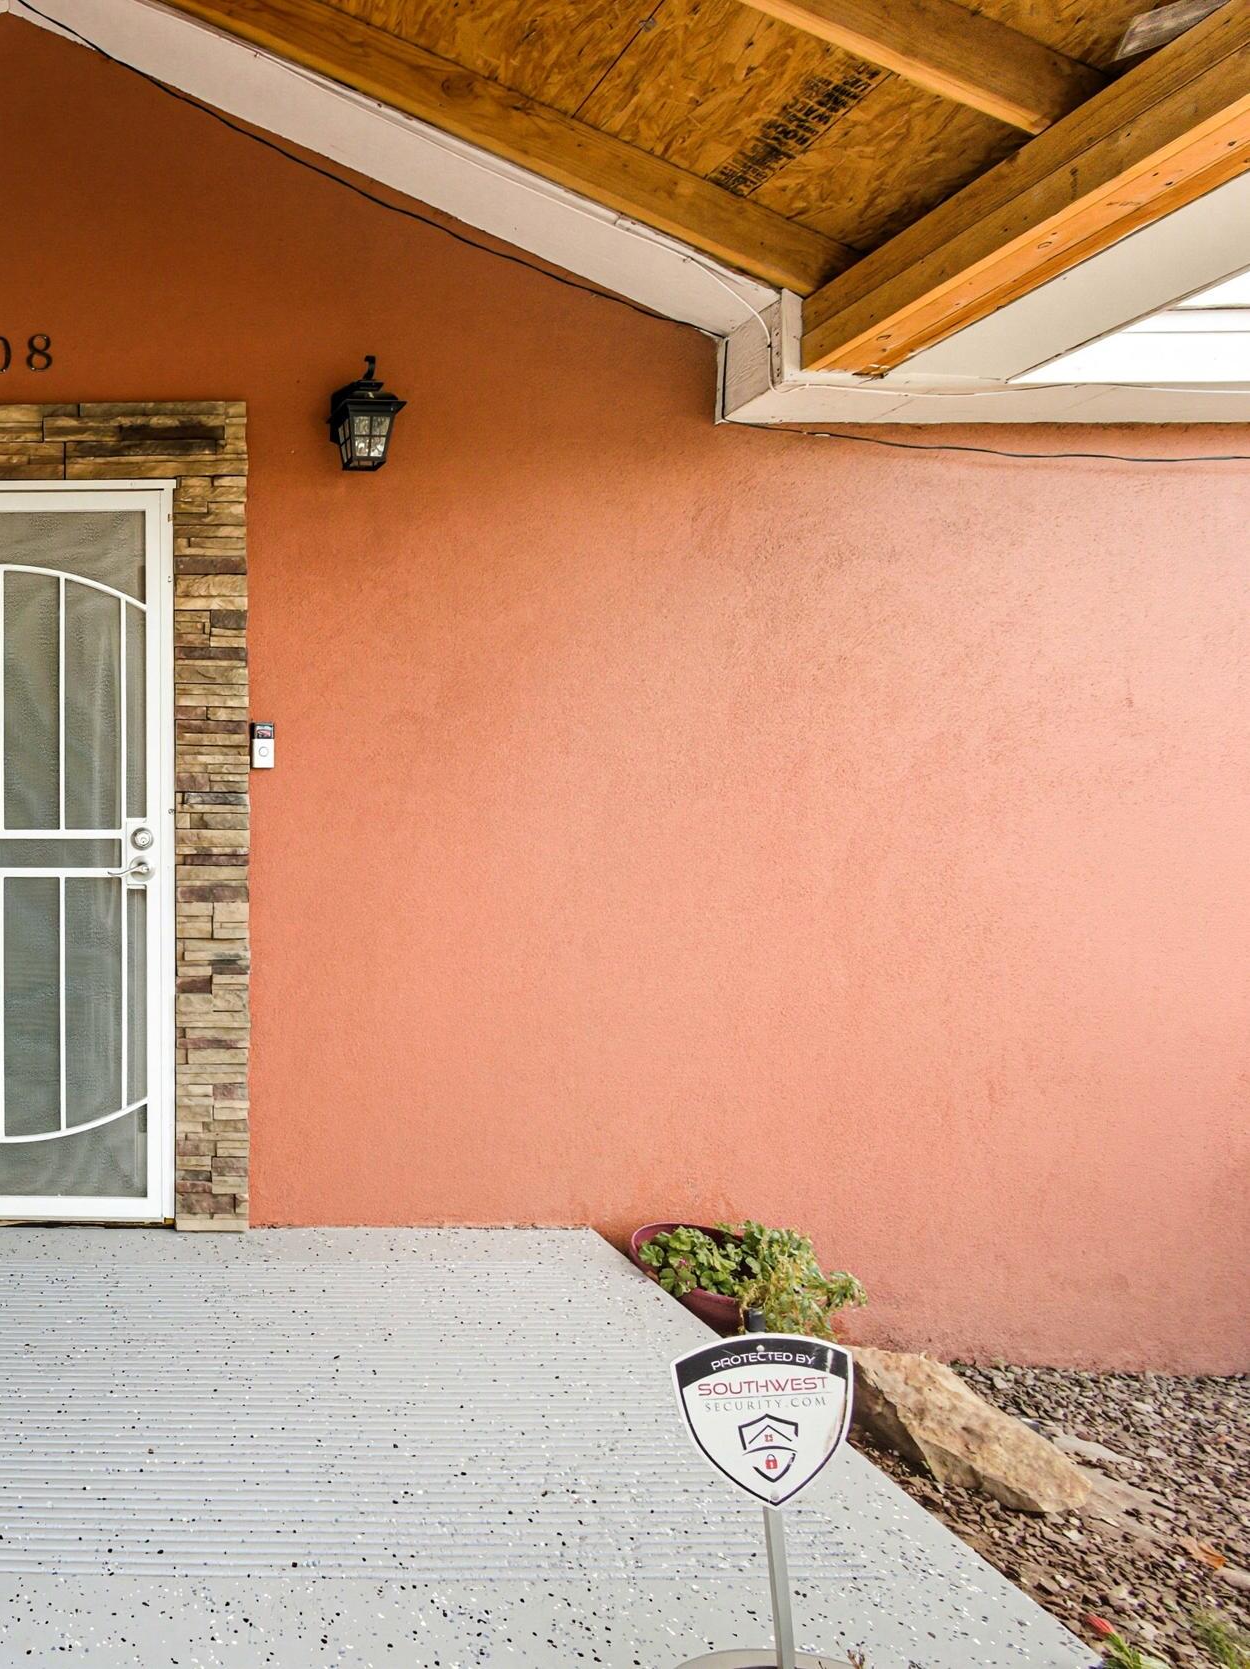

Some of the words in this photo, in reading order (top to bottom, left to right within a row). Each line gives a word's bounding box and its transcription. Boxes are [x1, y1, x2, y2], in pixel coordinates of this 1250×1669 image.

[711, 1352, 792, 1371] PROTECTED
[796, 1353, 816, 1365] BY
[698, 1376, 828, 1396] SOUTHWEST
